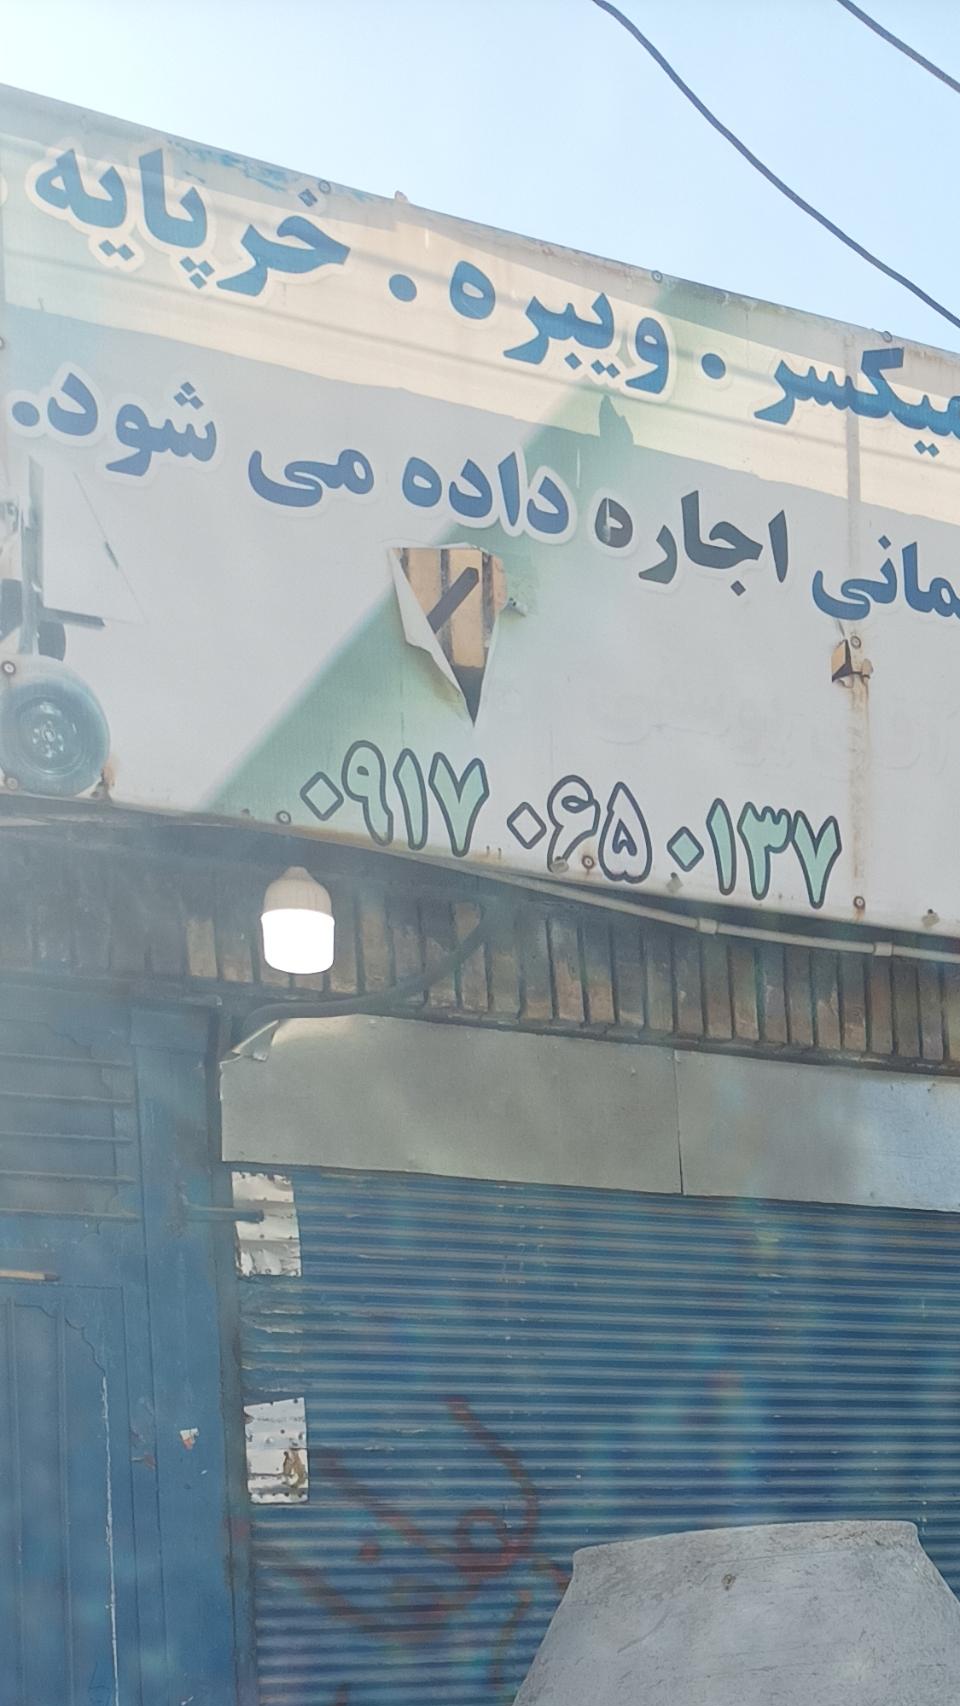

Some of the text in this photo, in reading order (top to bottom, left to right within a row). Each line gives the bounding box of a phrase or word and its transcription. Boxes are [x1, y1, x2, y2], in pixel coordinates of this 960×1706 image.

[449, 260, 668, 394] ویبره
[248, 448, 375, 507] می
[402, 451, 570, 534] داده
[594, 490, 788, 596] اجاره
